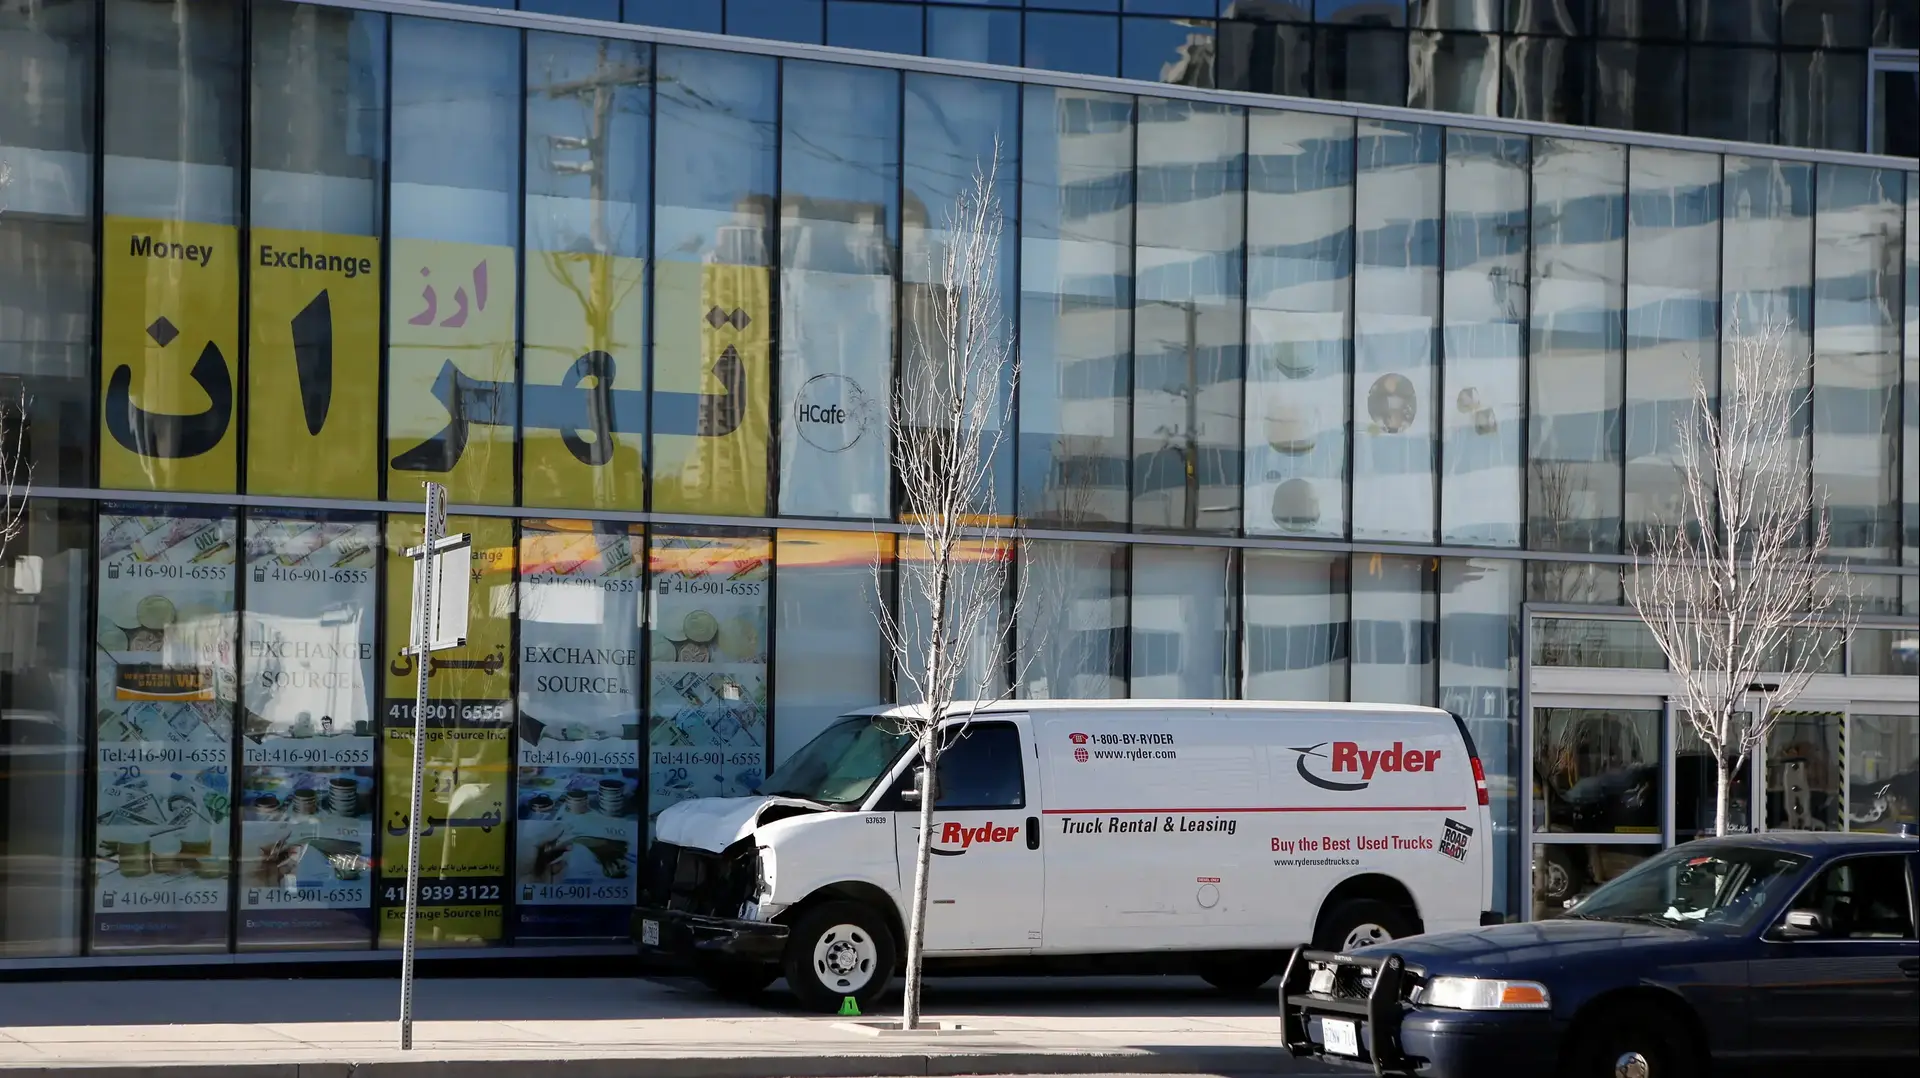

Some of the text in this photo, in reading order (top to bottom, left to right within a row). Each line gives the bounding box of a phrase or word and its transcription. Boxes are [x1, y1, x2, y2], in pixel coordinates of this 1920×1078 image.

[130, 235, 372, 278] Money Exchange
[408, 259, 488, 328] ارز
[799, 404, 846, 424] HCafe
[126, 564, 226, 580] 416-901-6555
[272, 569, 368, 584] 416-901-6555
[546, 576, 634, 592] 416901-6555
[675, 581, 761, 596] 416-901-6555
[249, 640, 372, 660] EXCHANGE
[525, 647, 637, 666] EXCHANGE
[262, 670, 350, 689] SOURCE
[537, 676, 617, 693] SOURCE
[427, 705, 456, 719] 901
[462, 705, 504, 720] 6555
[390, 729, 506, 742] Exchnge Source Inc.
[1091, 733, 1175, 745] 1-800-BY-RYDER
[100, 749, 226, 763] Tel:416-901-6555
[246, 748, 369, 763] Tel:416-901-6555
[523, 751, 635, 765] Tel:416-901-6555
[653, 752, 761, 765] Tel:416-901-6555
[1094, 748, 1177, 761] www.ryder.com
[1331, 741, 1442, 780] Ryder
[1061, 816, 1237, 835] Truck Rental & Leasing
[941, 821, 1020, 848] Ryder
[1444, 828, 1468, 848] ROAD
[1271, 835, 1433, 854] Buy the Best Used Trucks
[1439, 839, 1467, 861] READY
[1274, 857, 1360, 867] www.ryderusedtrucks.ca
[121, 890, 218, 905] 416-901-6555
[265, 889, 363, 903] 416-901-6555
[421, 886, 454, 900] 939
[458, 885, 500, 900] 3122
[540, 886, 629, 899] 416-901-6555
[387, 910, 441, 920] Excange
[443, 908, 481, 919] Source
